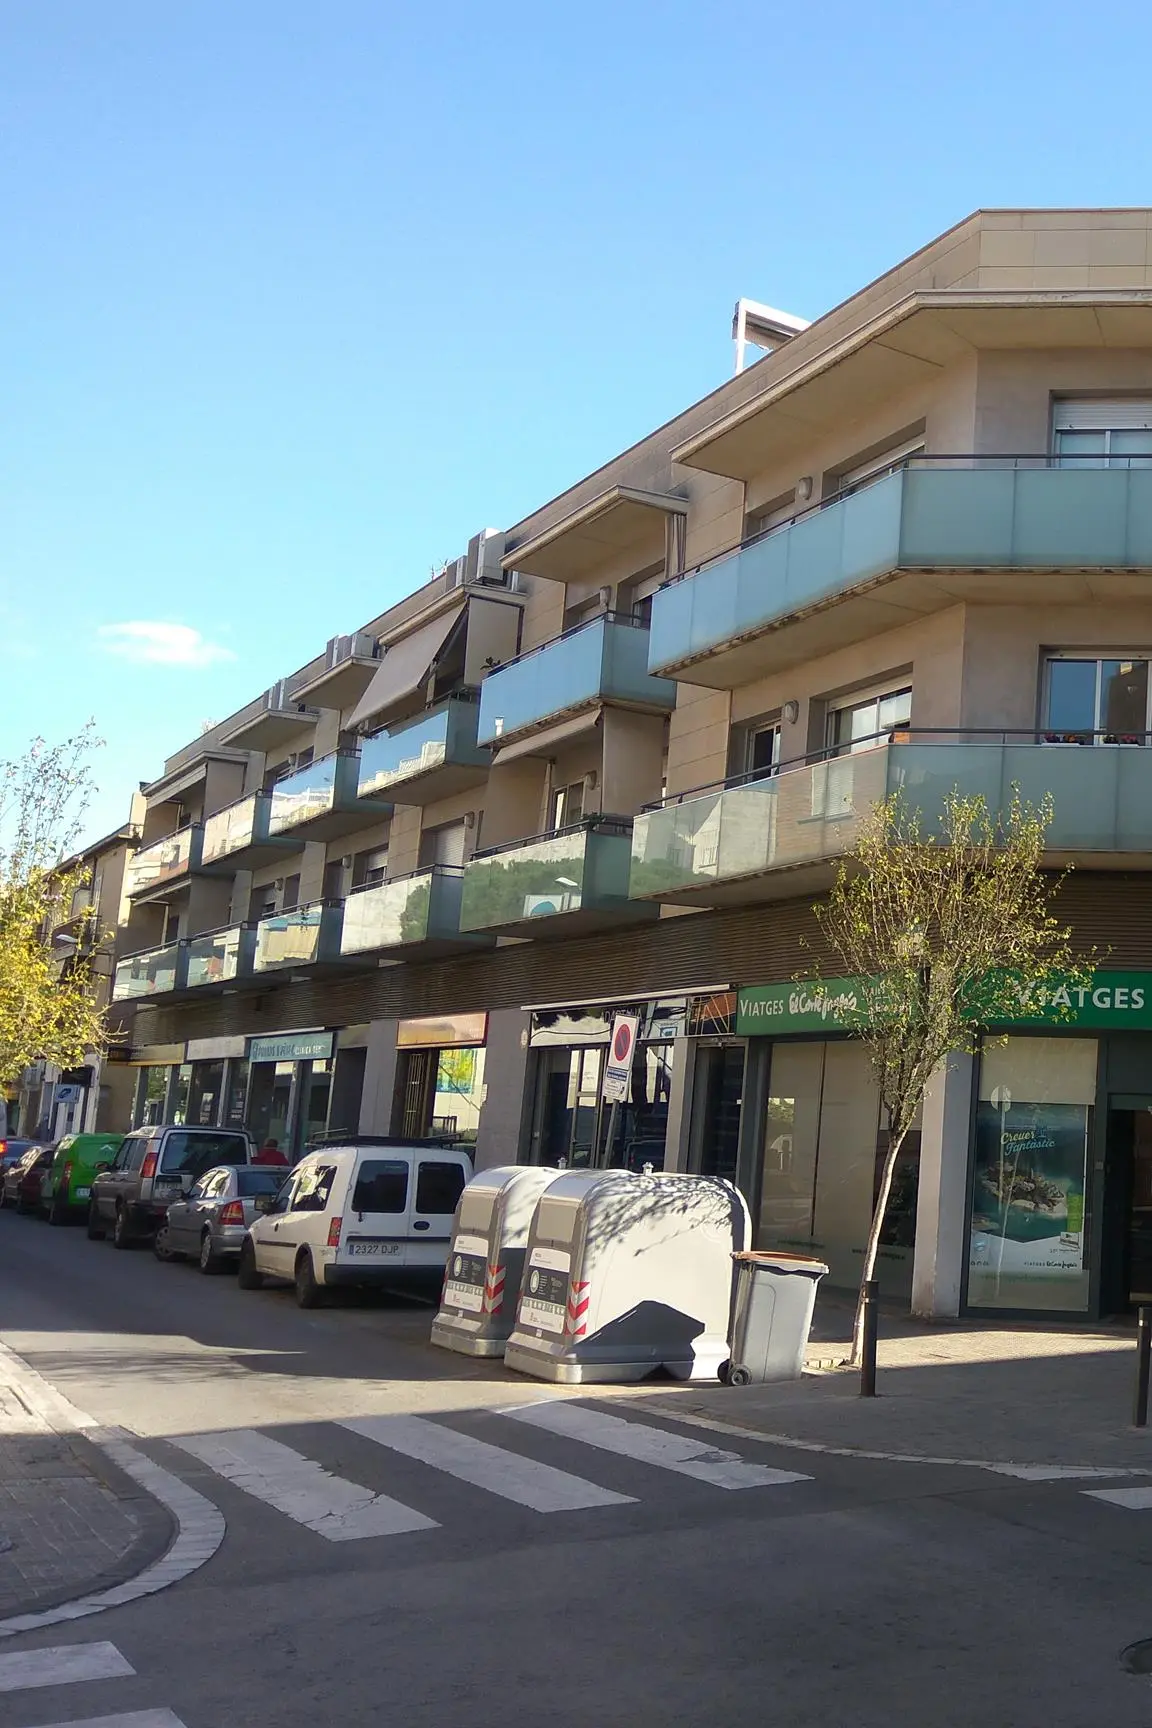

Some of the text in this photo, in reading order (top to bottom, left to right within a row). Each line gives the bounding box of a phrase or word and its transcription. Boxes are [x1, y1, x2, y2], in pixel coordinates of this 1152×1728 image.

[739, 999, 784, 1017] VIATGES
[1000, 1130, 1035, 1145] Creuer
[355, 1245, 399, 1254] 2327 DJP
